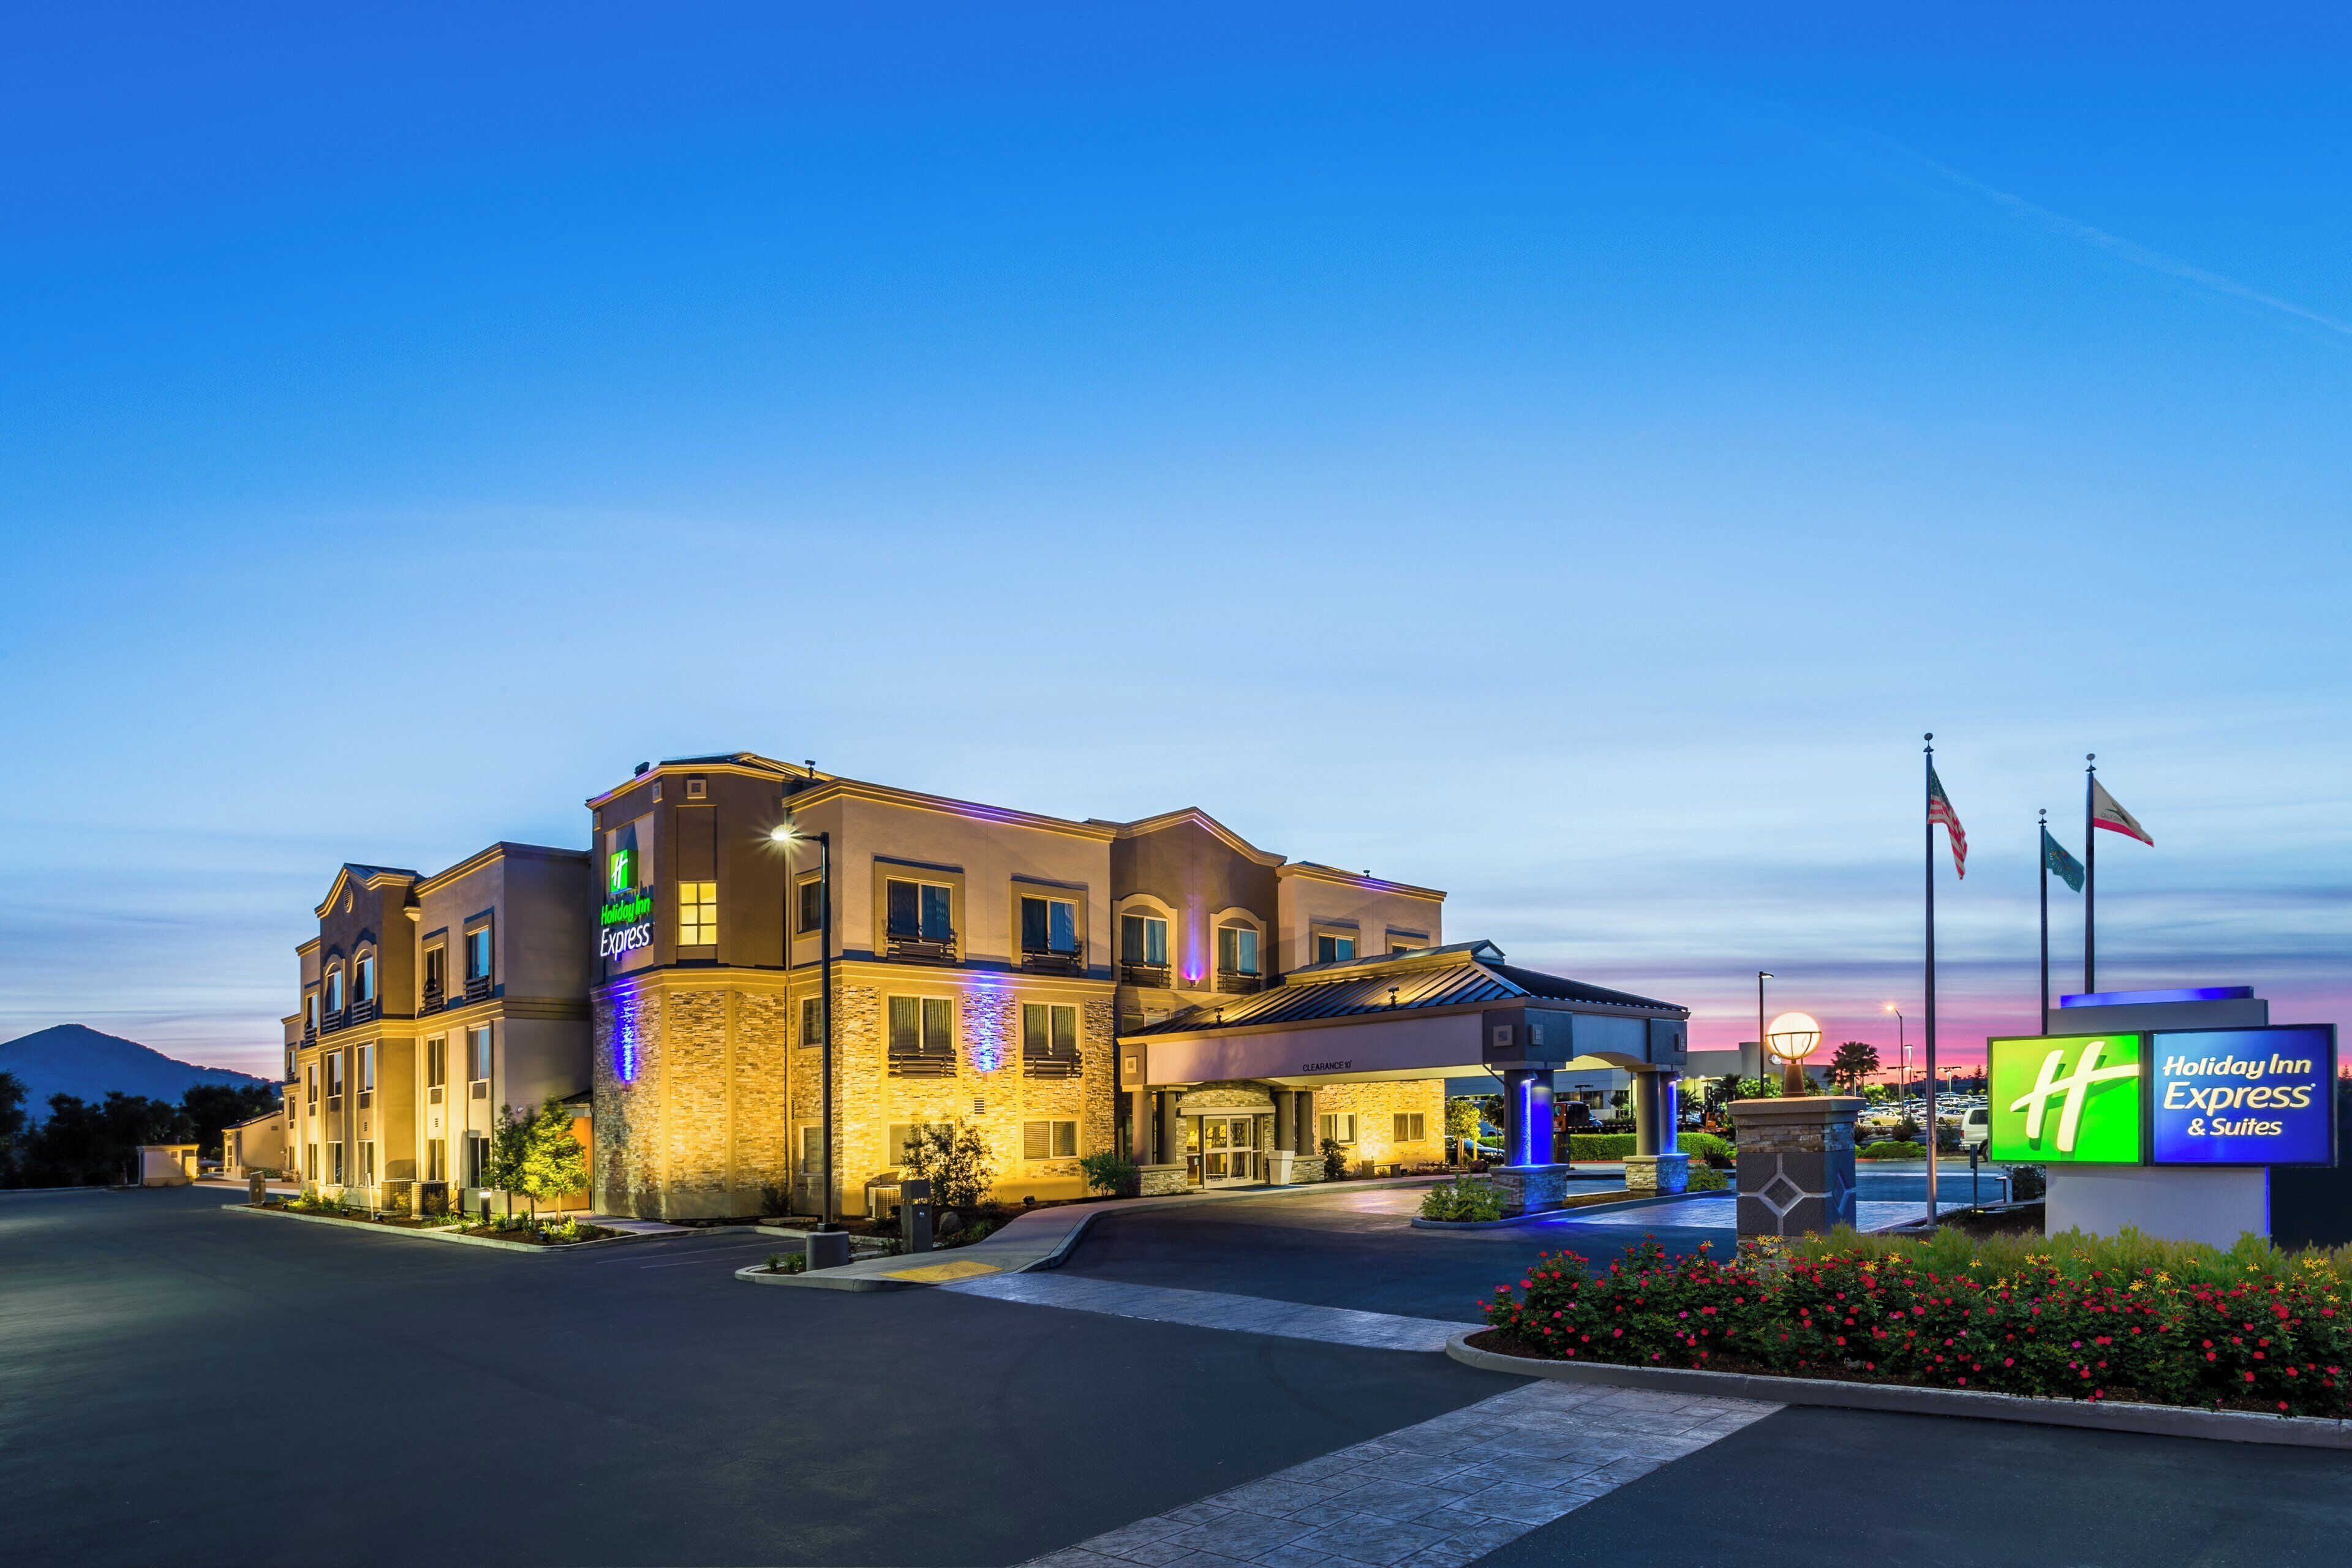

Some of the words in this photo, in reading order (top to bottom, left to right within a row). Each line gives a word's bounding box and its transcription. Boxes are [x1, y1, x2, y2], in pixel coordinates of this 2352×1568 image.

[601, 900, 635, 926] Holiday
[635, 894, 651, 916] Inn
[600, 922, 650, 961] Express
[1303, 1061, 1344, 1072] CLEARANCE
[2162, 1055, 2266, 1079] Holiday
[2269, 1054, 2312, 1074] Inn
[2163, 1081, 2312, 1117] Express
[2187, 1118, 2206, 1136] &
[2209, 1118, 2283, 1136] Suites
